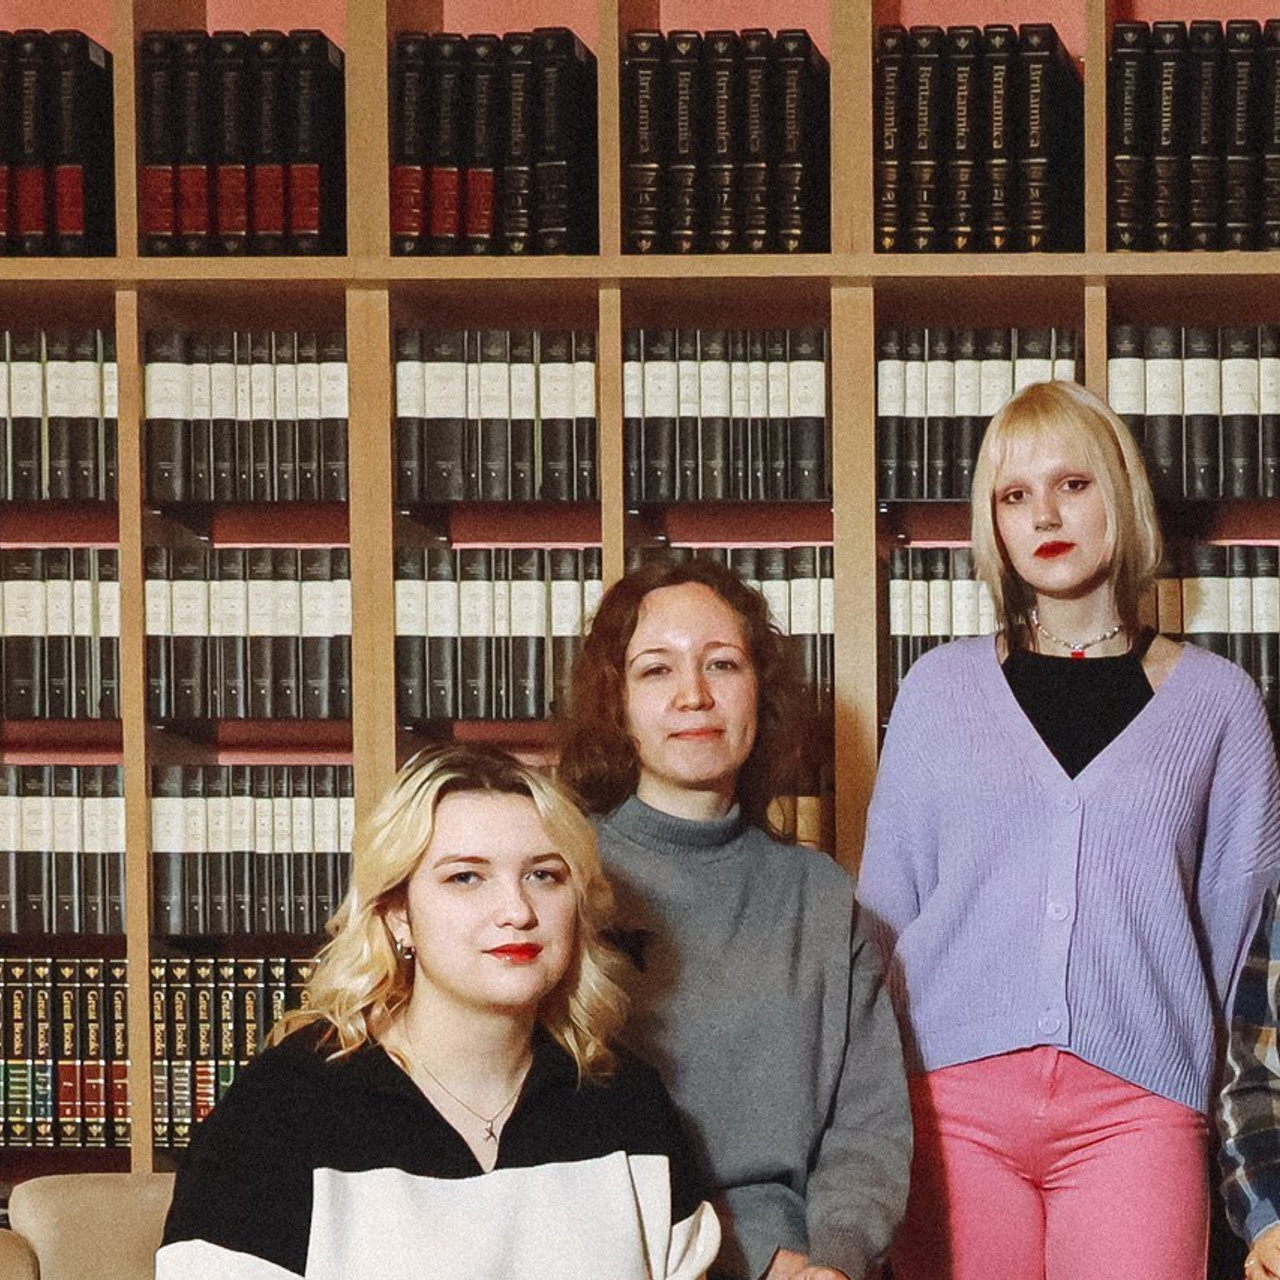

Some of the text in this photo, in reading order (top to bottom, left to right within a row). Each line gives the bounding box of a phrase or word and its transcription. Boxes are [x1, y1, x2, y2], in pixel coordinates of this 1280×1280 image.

[13, 989, 24, 1019] Great
[37, 989, 49, 1019] Great
[174, 990, 186, 1020] Great
[198, 990, 210, 1020] Great
[13, 1022, 24, 1056] Books
[37, 1022, 49, 1056] Books
[62, 990, 75, 1056] Great Books
[87, 990, 99, 1056] Great Books
[113, 990, 125, 1056] Great Books
[153, 990, 165, 1056] Great Books
[175, 1023, 187, 1056] Books
[199, 1023, 210, 1056] Books
[221, 990, 233, 1056] Great Books
[245, 990, 257, 1056] Great Books
